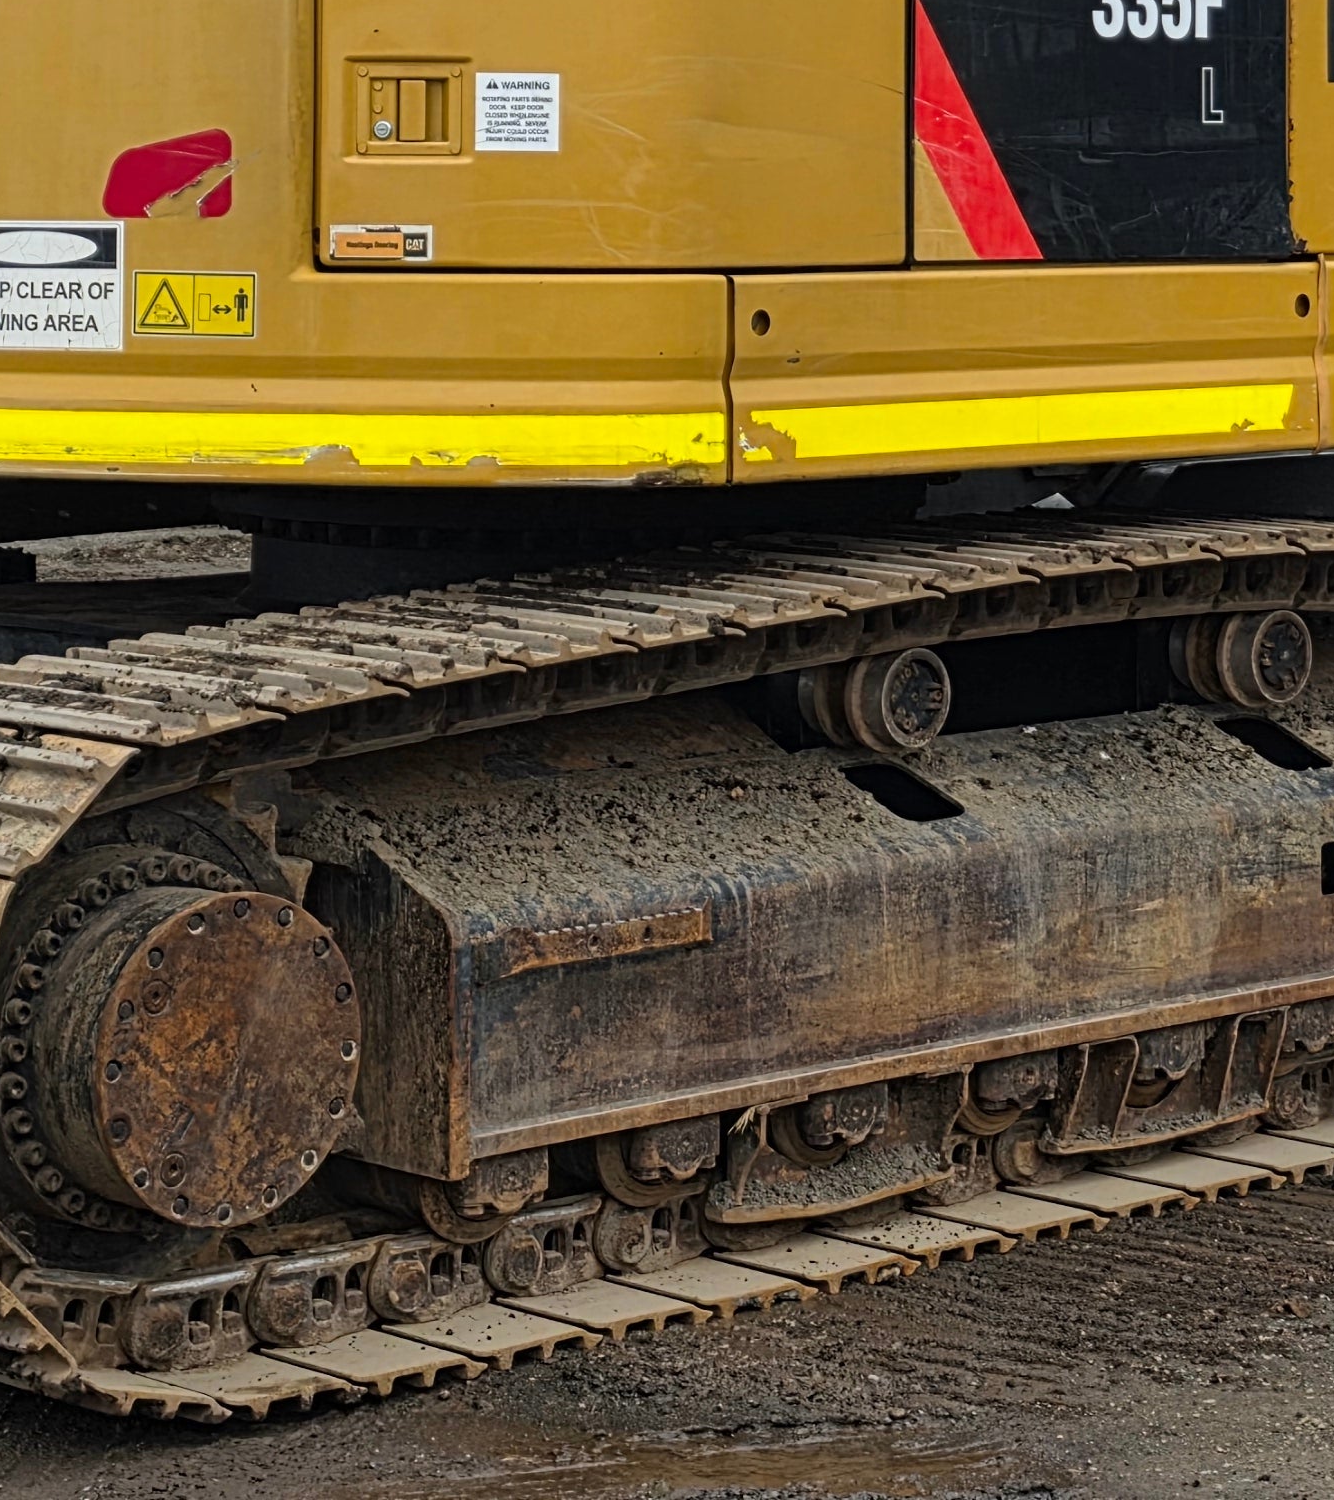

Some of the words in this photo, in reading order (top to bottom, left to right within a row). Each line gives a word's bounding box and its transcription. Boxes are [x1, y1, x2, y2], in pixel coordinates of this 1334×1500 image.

[501, 81, 550, 90] WARNING
[1202, 67, 1224, 124] L
[406, 239, 424, 250] CAT
[17, 281, 82, 299] CLEAR
[88, 282, 114, 300] OF
[43, 315, 98, 332] AREA
